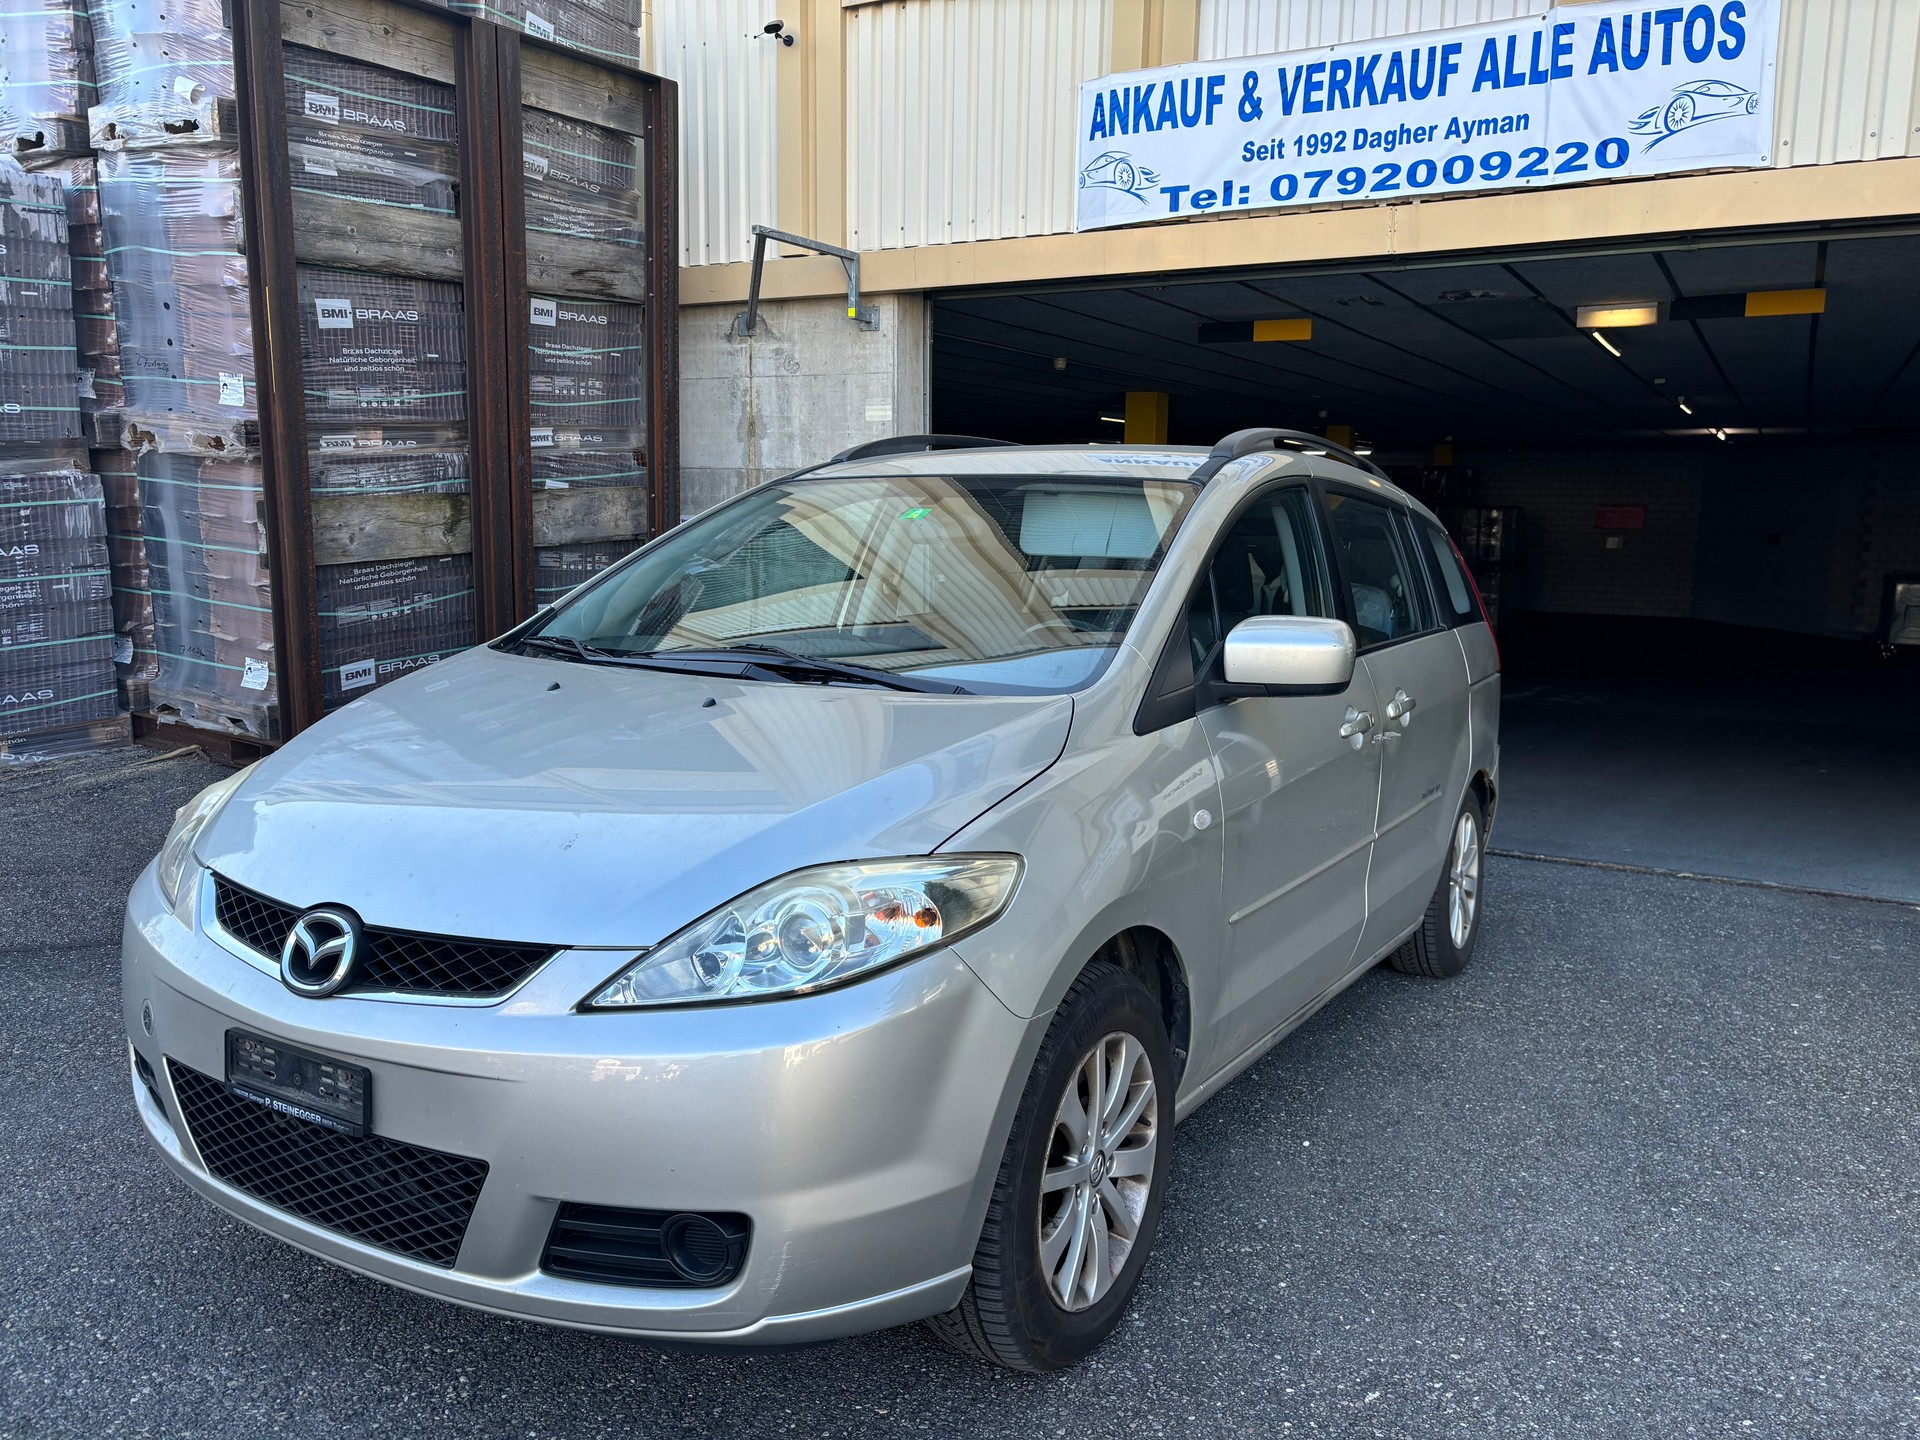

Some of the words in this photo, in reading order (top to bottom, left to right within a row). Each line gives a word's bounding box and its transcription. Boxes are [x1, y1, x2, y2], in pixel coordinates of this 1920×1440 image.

[1090, 75, 1225, 141] ANKAUF
[1238, 71, 1263, 122] &
[1278, 43, 1462, 116] VERKAUF
[1472, 22, 1575, 92] ALLE
[1588, 1, 1747, 75] AUTOS
[308, 101, 336, 116] BMI
[343, 109, 407, 133] BRAAS
[1242, 139, 1285, 162] Seit
[1293, 131, 1347, 156] 1992
[1353, 124, 1439, 152] Dagher
[1444, 111, 1530, 144] Ayman
[550, 169, 601, 193] BRAAS
[1160, 180, 1249, 212] Tel:
[1270, 138, 1629, 201] 0792009220
[321, 309, 348, 319] BMI
[356, 309, 418, 321] BRAAS
[533, 307, 553, 317] BMI
[559, 311, 607, 325] BRAAS
[329, 356, 367, 364] Natürliche
[368, 356, 416, 365] Geborgenheit
[364, 347, 403, 356] Dachziegel
[339, 574, 378, 585] Natürliche
[379, 565, 428, 578] Geborgenheit
[375, 560, 414, 571] Dachziegel
[354, 582, 369, 590] und
[370, 580, 394, 588] zeitlos
[395, 575, 416, 584] schön
[345, 668, 371, 681] BMI
[379, 654, 440, 674] BRAAS
[265, 1097, 272, 1108] P.
[273, 1101, 321, 1124] STEINEGGER
